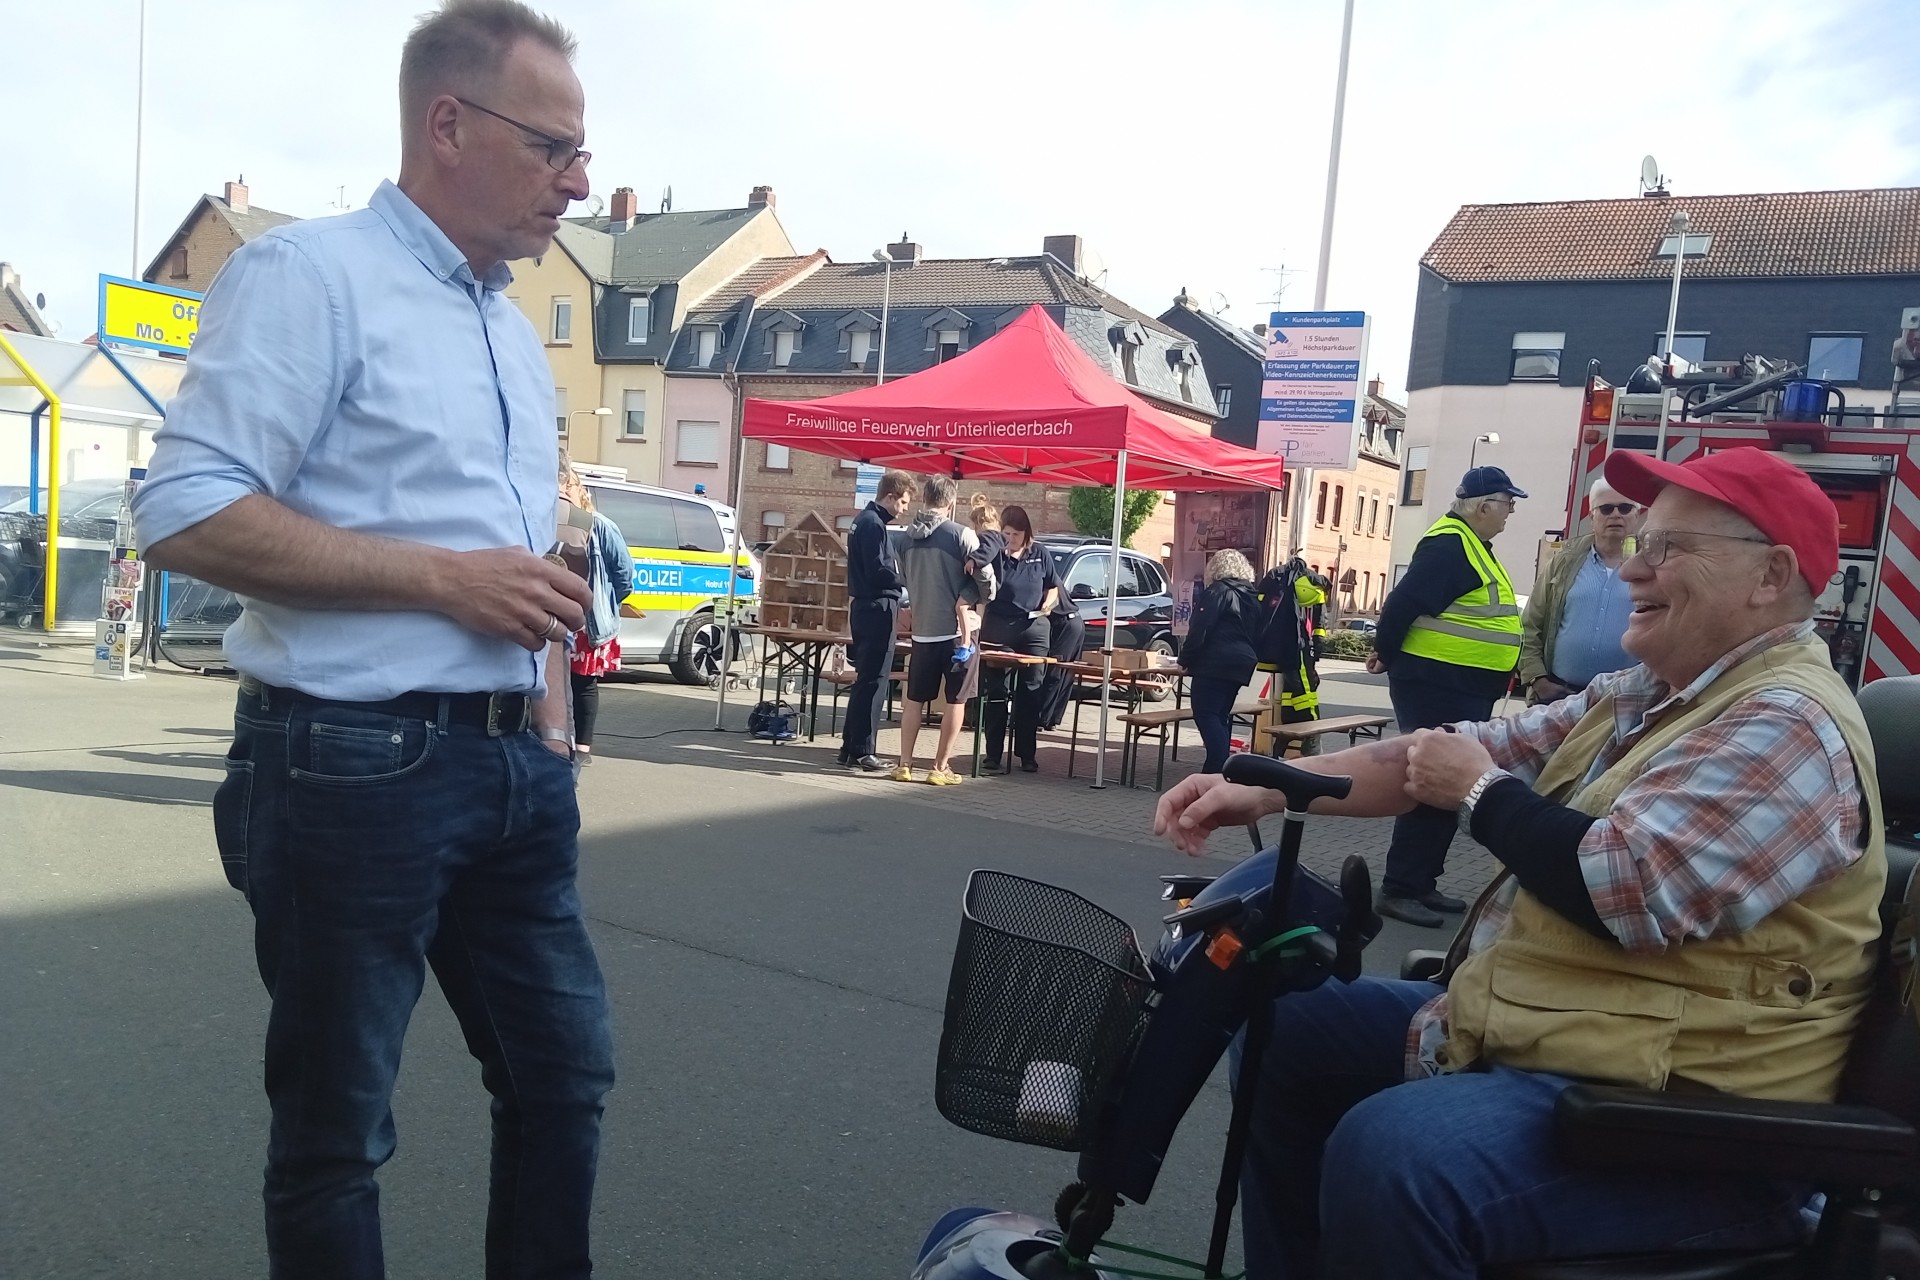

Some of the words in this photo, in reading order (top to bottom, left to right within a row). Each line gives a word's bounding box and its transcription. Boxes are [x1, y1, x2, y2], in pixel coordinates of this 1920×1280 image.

[1292, 316, 1341, 324] Kundenparkplatz
[136, 323, 169, 342] Mo.
[1302, 344, 1356, 352] Höchstparkdauer
[1267, 362, 1299, 371] Erfassung
[1311, 362, 1345, 370] Parkdauer
[1265, 371, 1357, 380] Video-Kennzeichenerkennung
[786, 413, 857, 433] Freiwillige
[861, 418, 941, 437] Feuerwehr
[946, 418, 1073, 437] Unterliederbach
